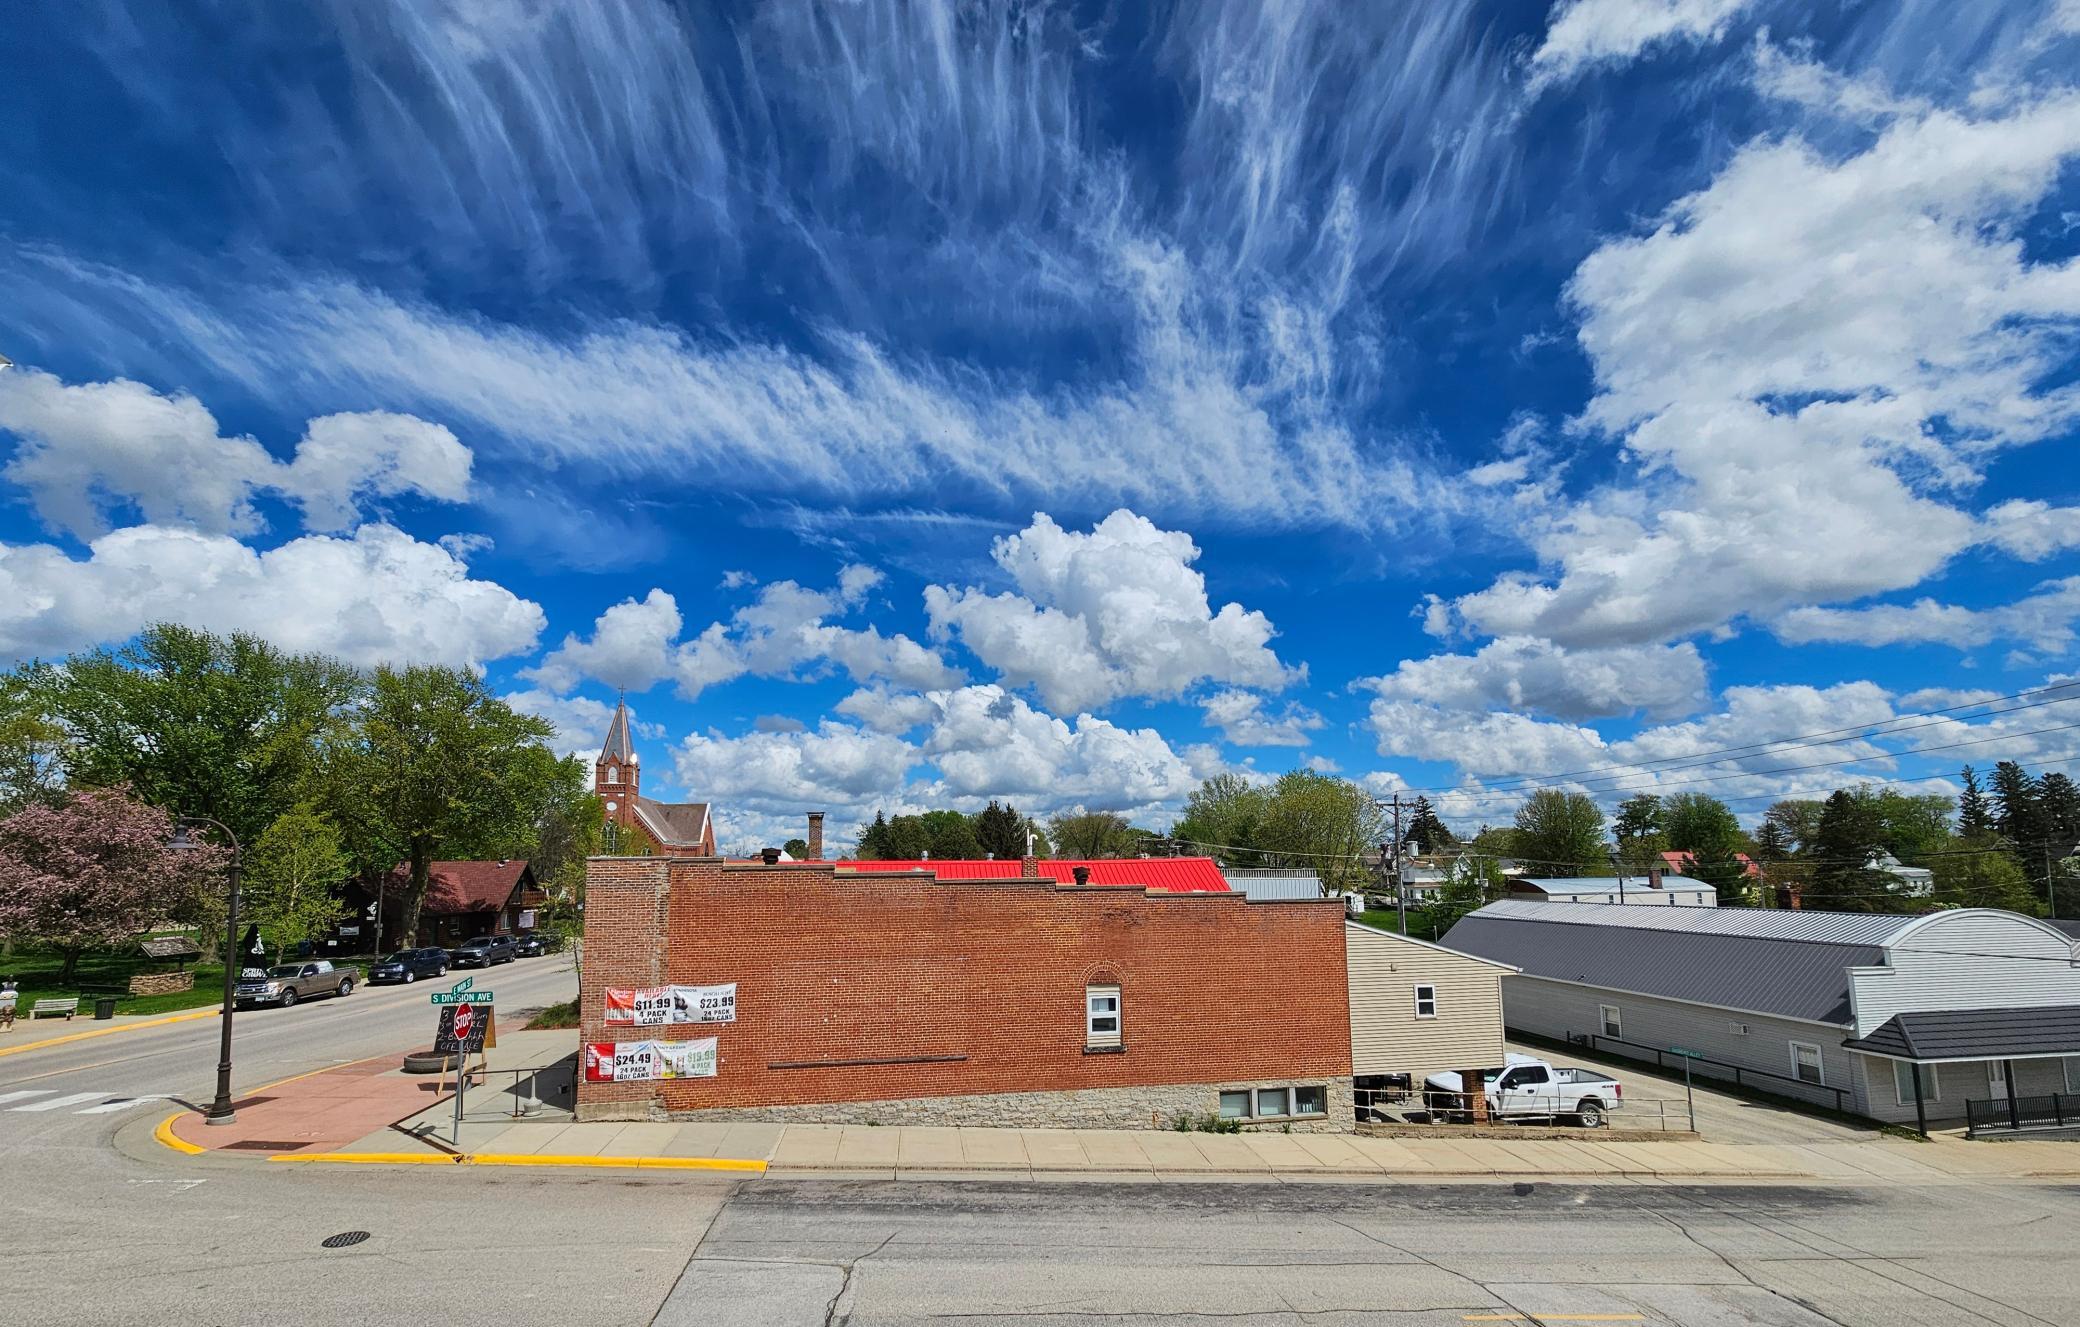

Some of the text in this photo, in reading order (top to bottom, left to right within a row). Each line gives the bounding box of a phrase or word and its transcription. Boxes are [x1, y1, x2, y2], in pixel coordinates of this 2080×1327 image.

[453, 978, 472, 995] E MAIN ST
[432, 993, 492, 1003] S DIVISION AVE
[635, 998, 671, 1011] $11.99
[700, 996, 734, 1010] $23.99
[455, 1012, 472, 1030] STOP
[642, 1017, 664, 1025] CANS
[615, 1053, 651, 1066] $24.49
[687, 1050, 715, 1063] $19.99
